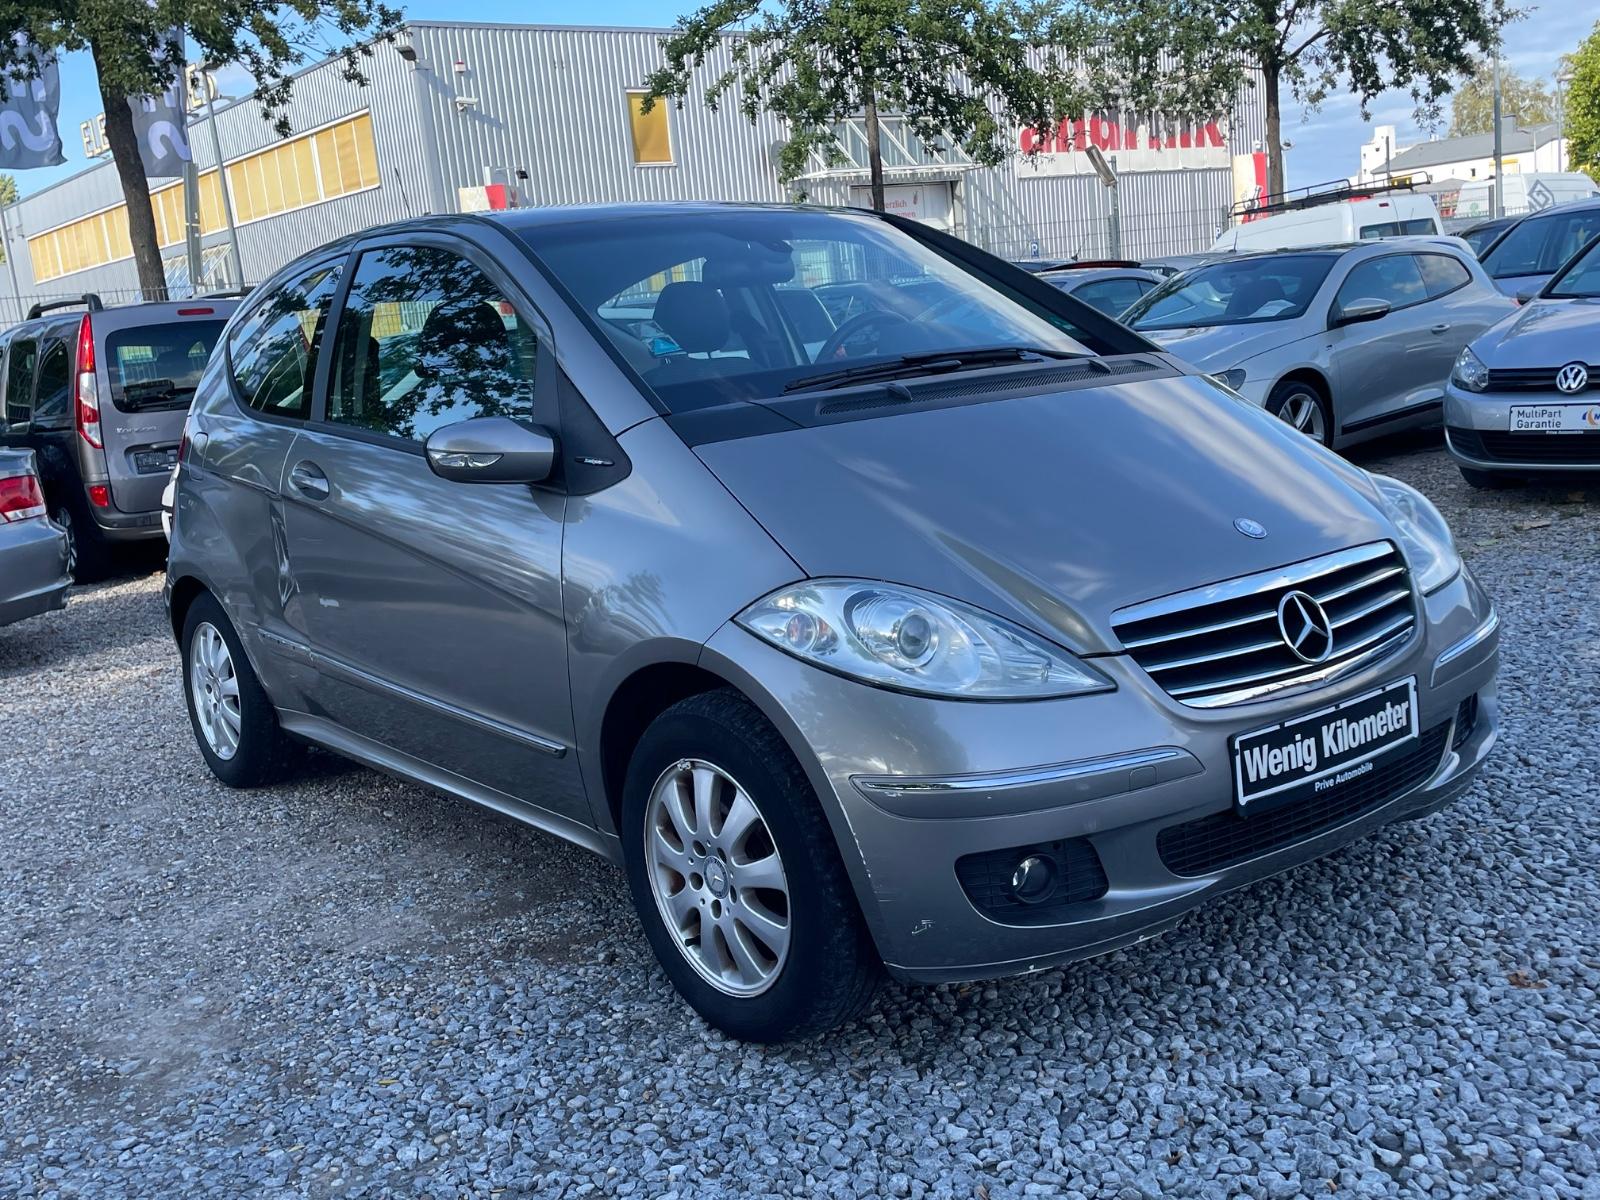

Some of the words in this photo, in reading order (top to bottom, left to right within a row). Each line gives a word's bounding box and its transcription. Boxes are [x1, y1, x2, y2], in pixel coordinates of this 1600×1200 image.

[1517, 409, 1562, 418] MultiPart
[1517, 419, 1562, 428] Garantie
[1244, 734, 1317, 783] Wenig
[1322, 701, 1408, 758] Kilometer
[1314, 778, 1334, 792] Prive
[1335, 763, 1373, 785] Automobile
